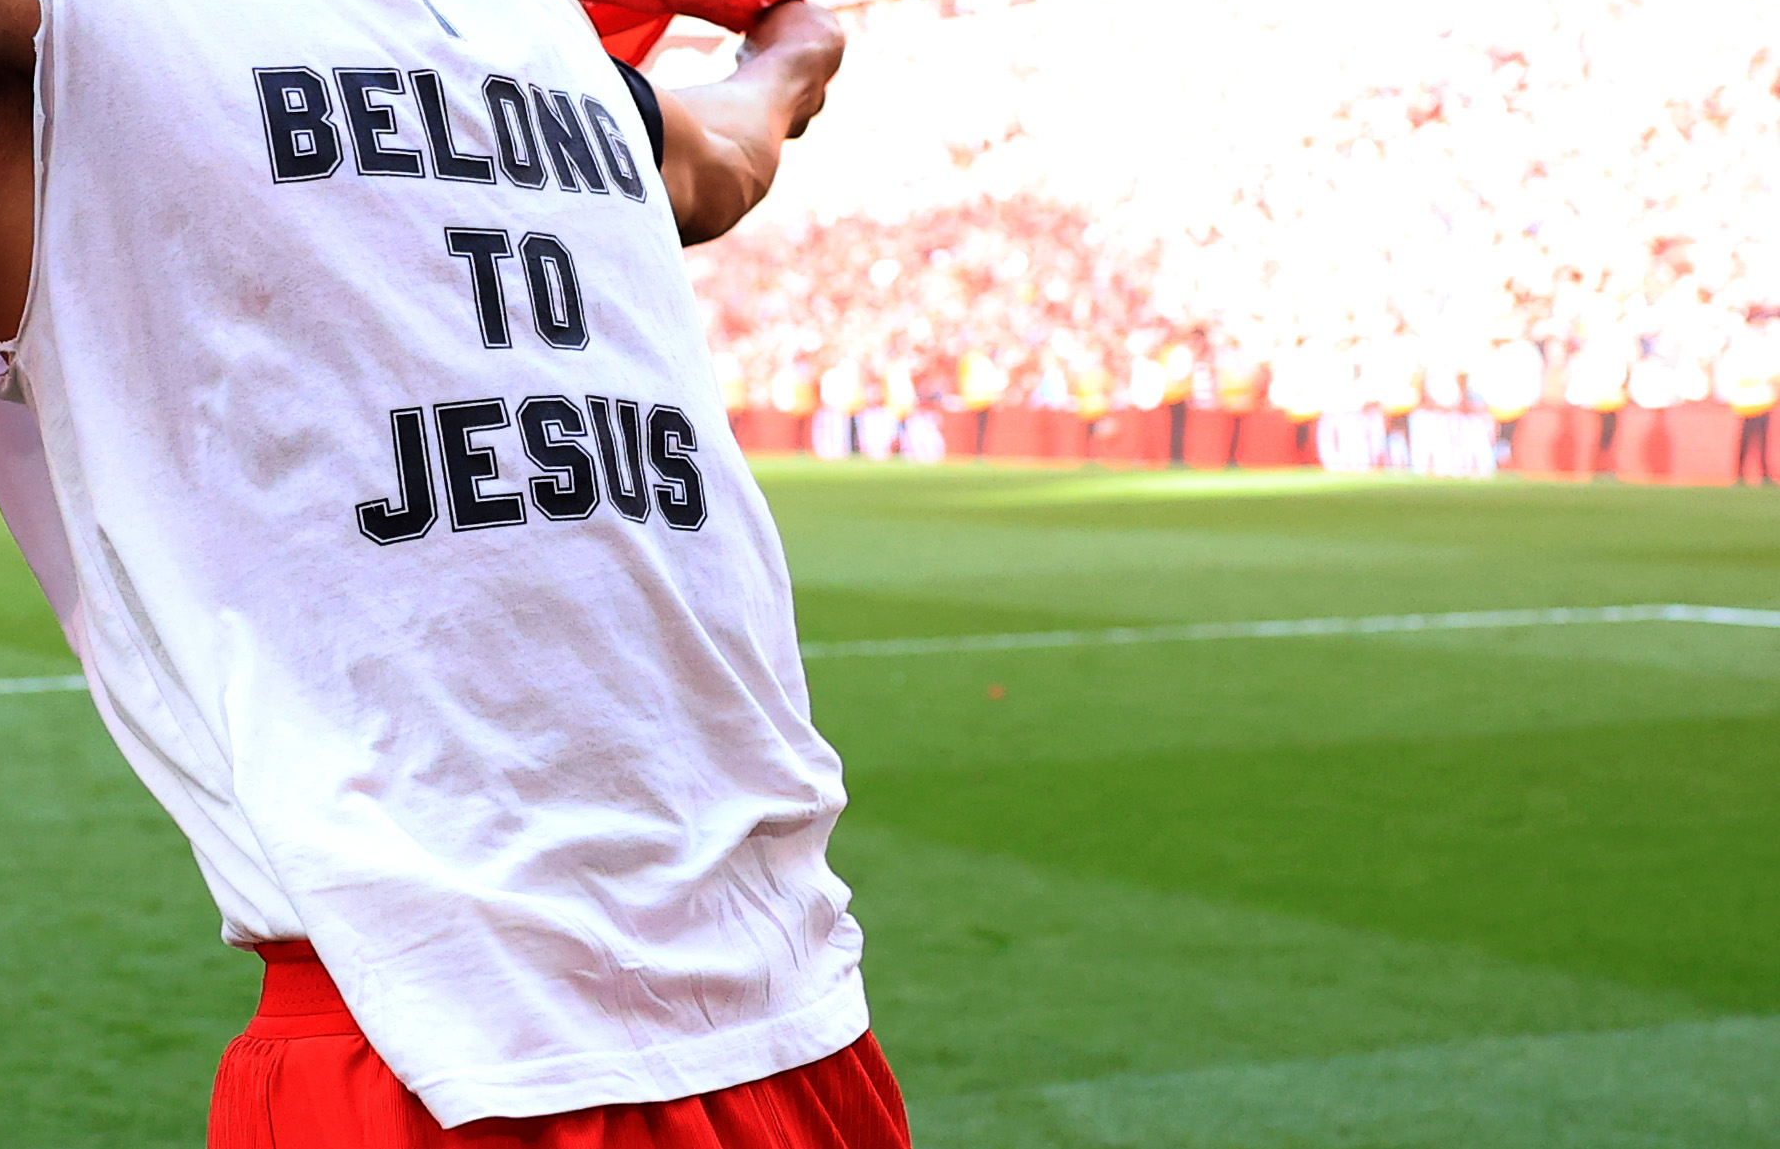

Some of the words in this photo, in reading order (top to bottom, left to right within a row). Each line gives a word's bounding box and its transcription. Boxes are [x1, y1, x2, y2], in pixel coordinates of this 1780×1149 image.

[252, 66, 648, 204] BELONG
[444, 226, 590, 351] TO
[355, 394, 708, 546] JESUS
